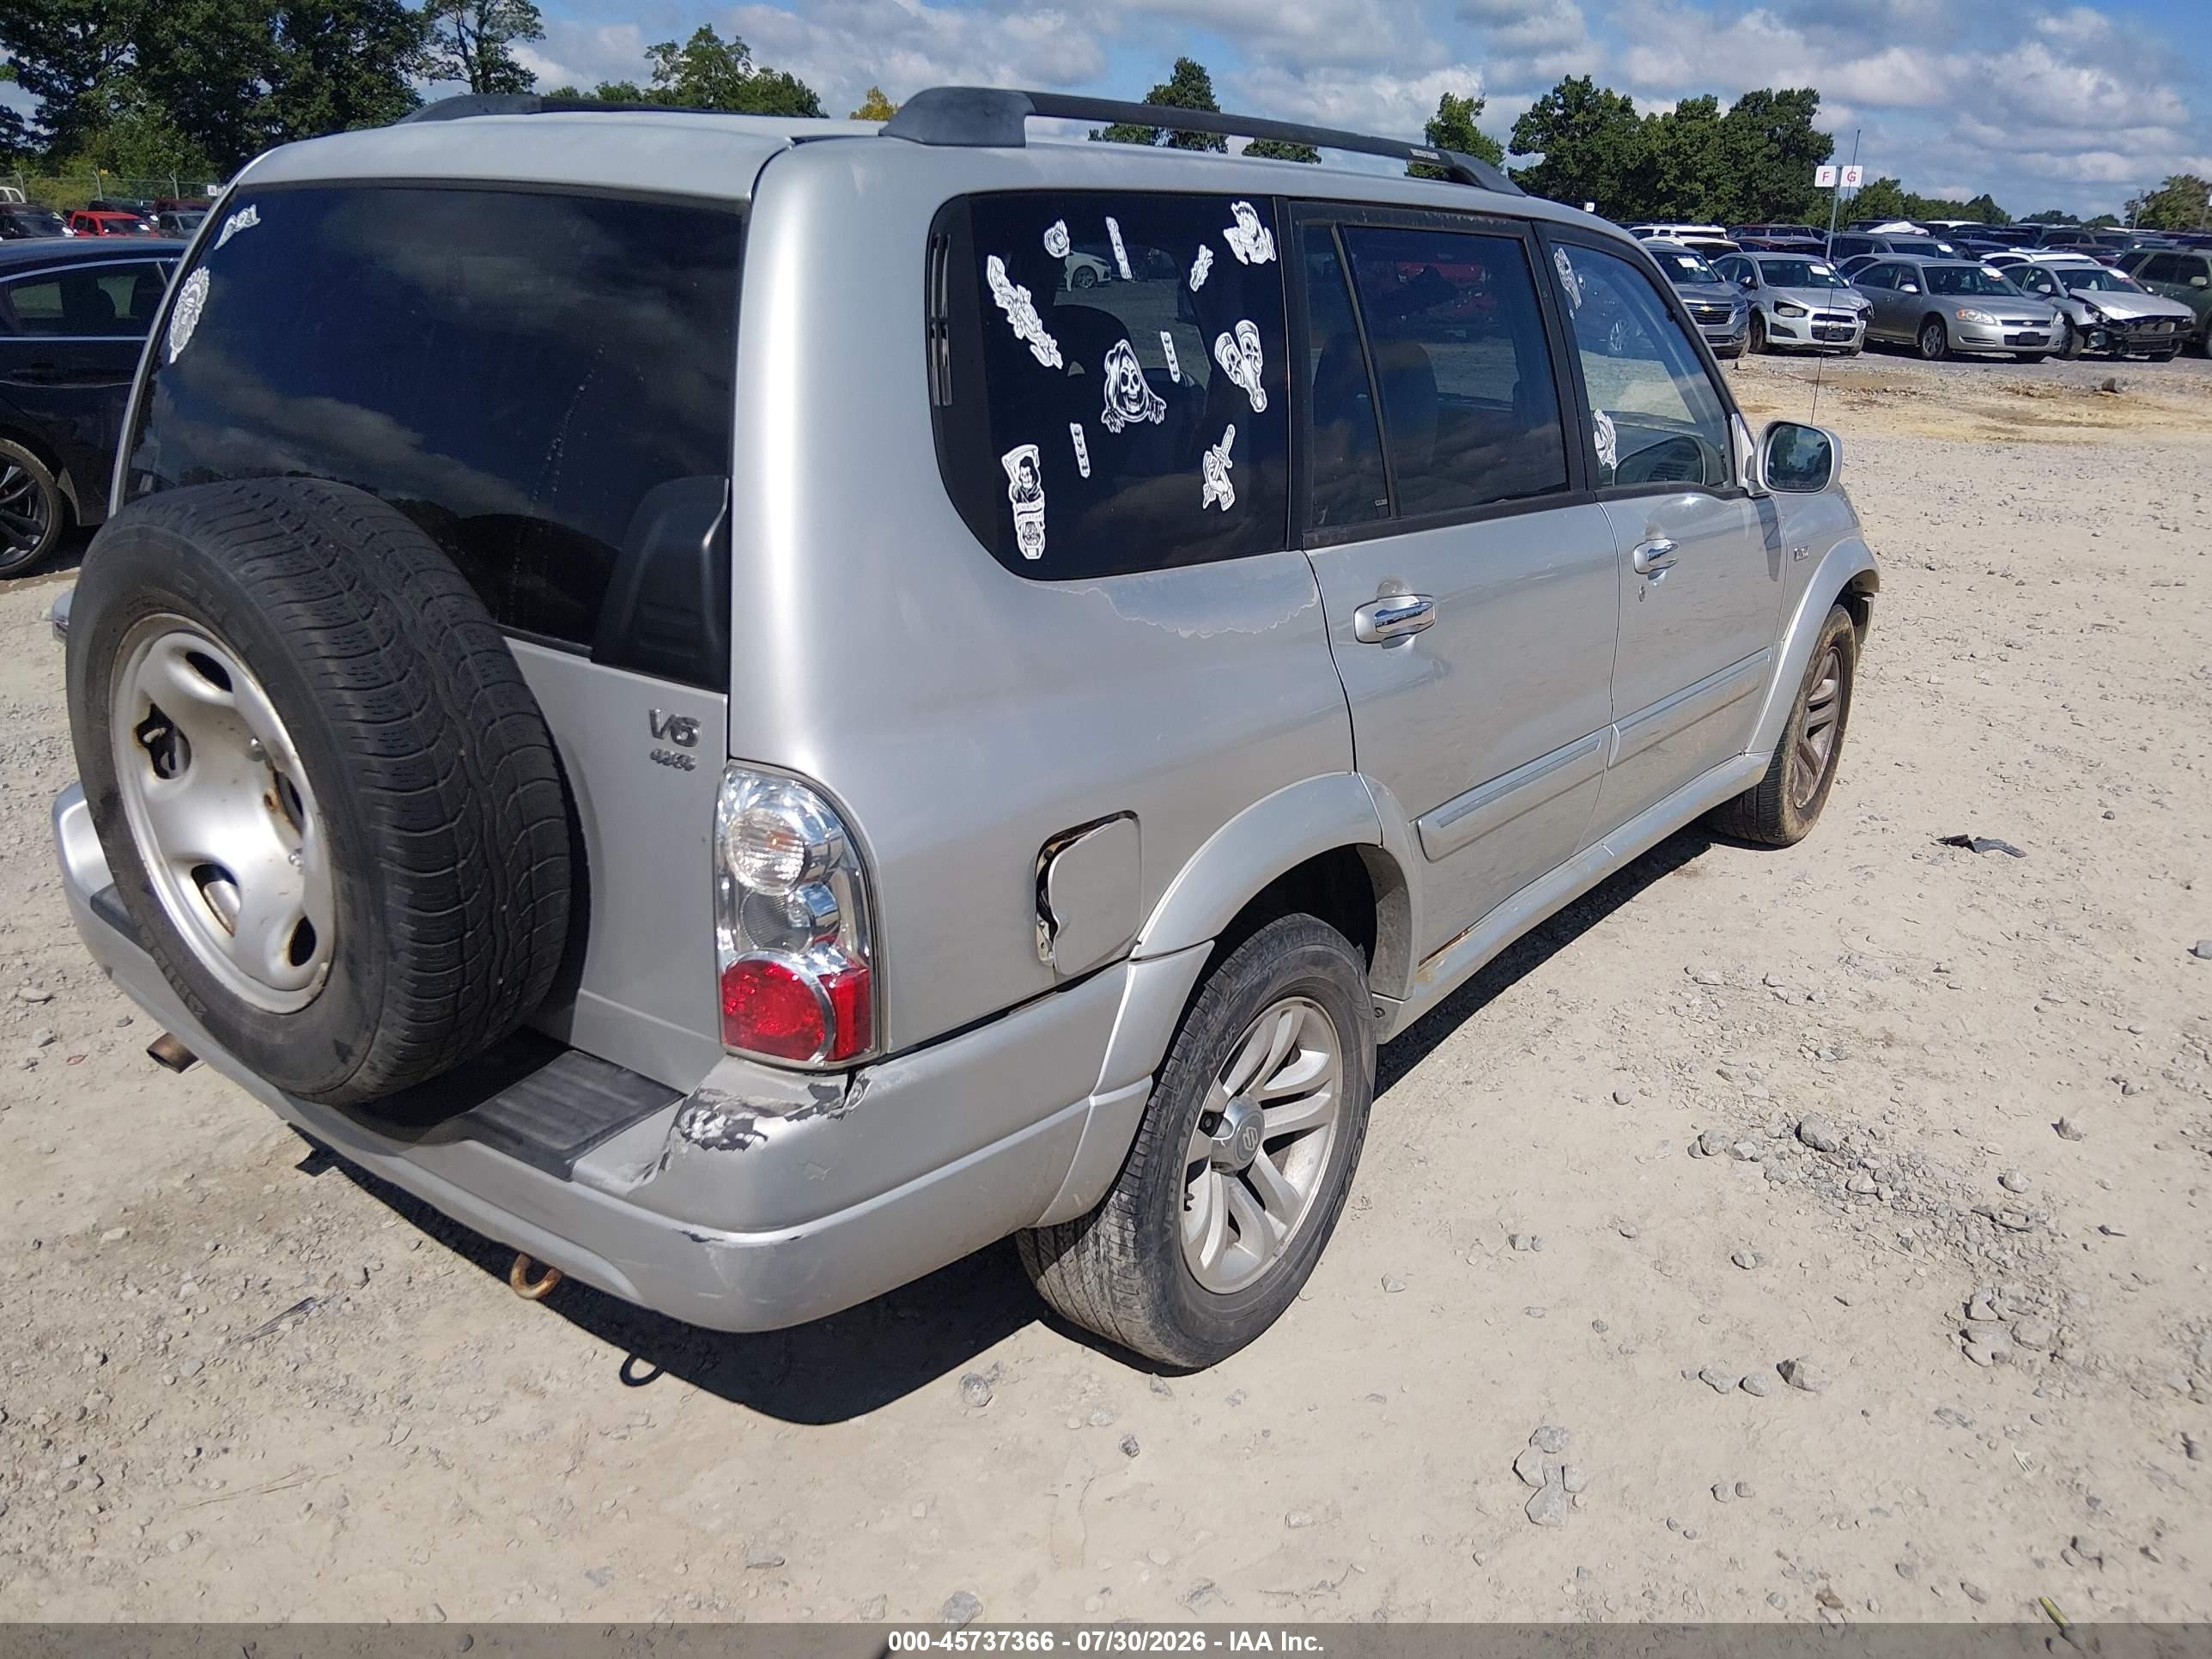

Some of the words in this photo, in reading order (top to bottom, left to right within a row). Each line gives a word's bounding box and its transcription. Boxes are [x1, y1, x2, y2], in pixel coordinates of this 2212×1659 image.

[1822, 171, 1831, 182] F
[1846, 171, 1857, 183] G
[649, 708, 701, 747] V6
